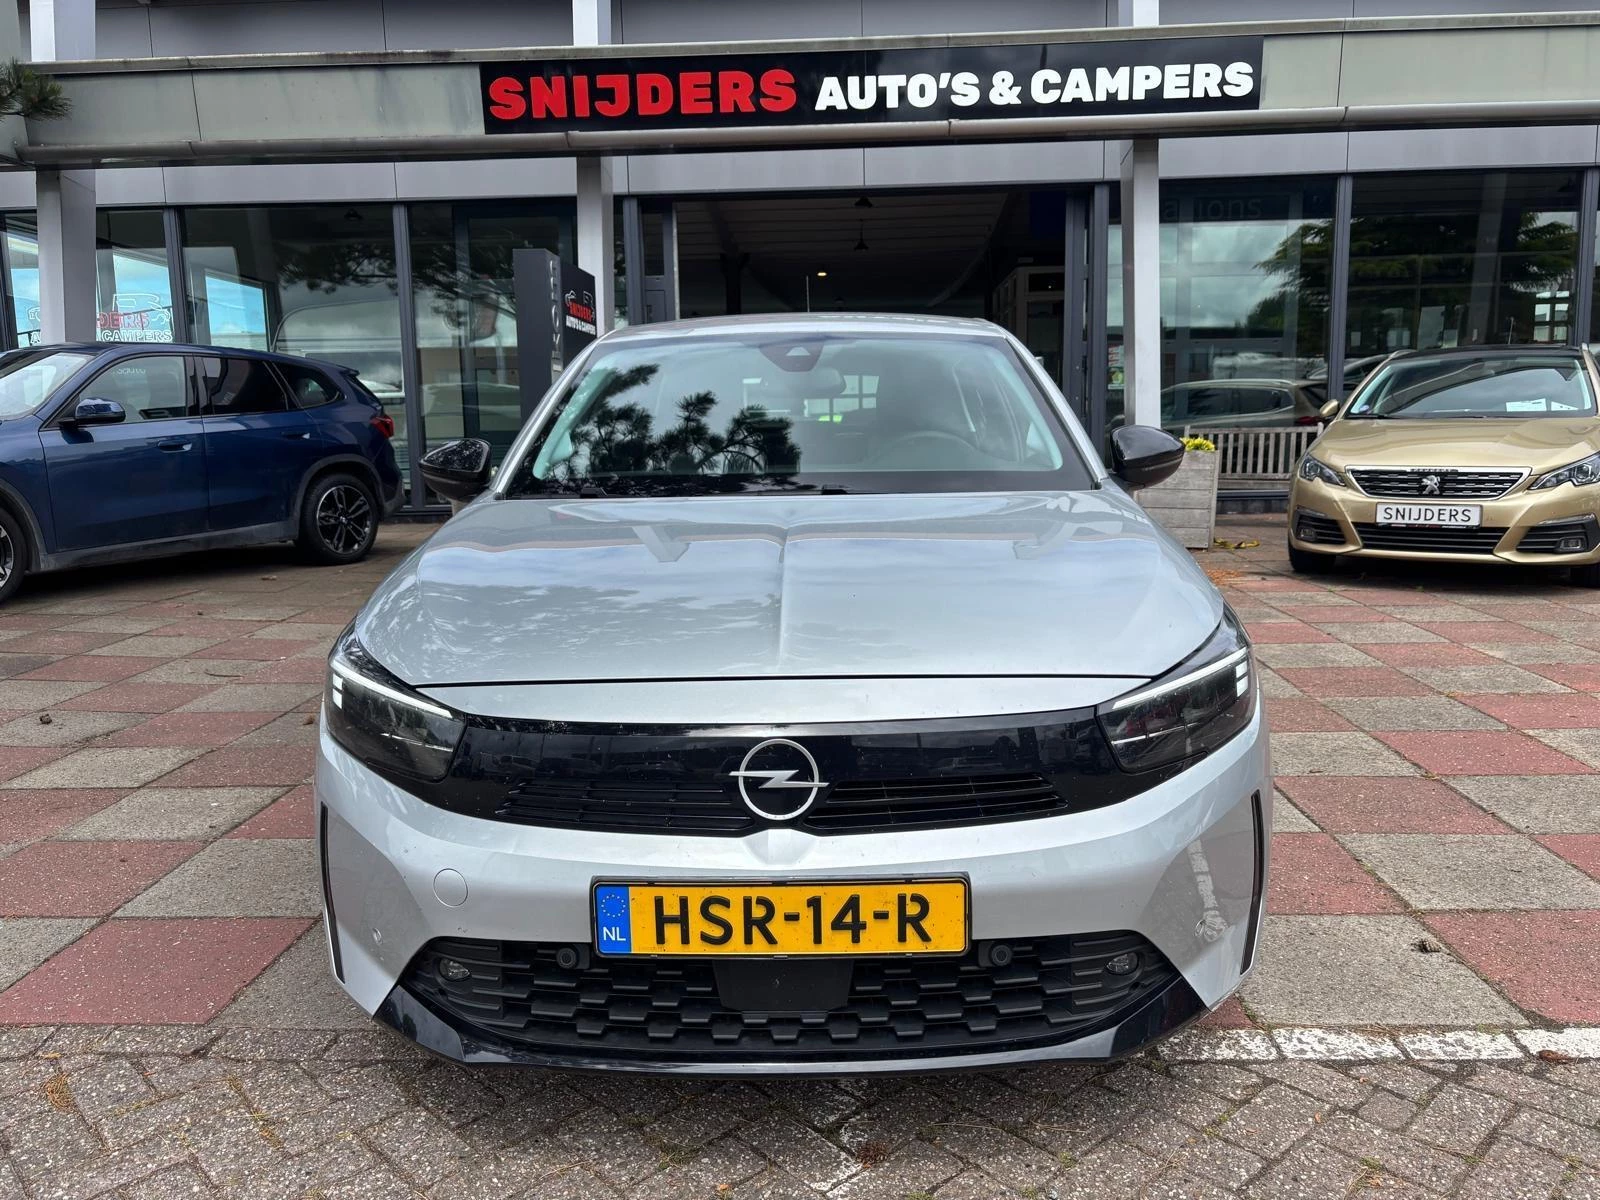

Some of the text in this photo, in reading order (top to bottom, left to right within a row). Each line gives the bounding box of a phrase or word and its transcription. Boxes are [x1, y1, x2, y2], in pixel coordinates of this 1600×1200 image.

[489, 61, 1254, 120] SNIJDERS AUTO'S & CAMPERS
[96, 312, 150, 328] DERS
[102, 329, 173, 342] CAMPERS
[1383, 506, 1472, 523] SNIJDERS
[603, 893, 932, 945] NL HSR-14-R
